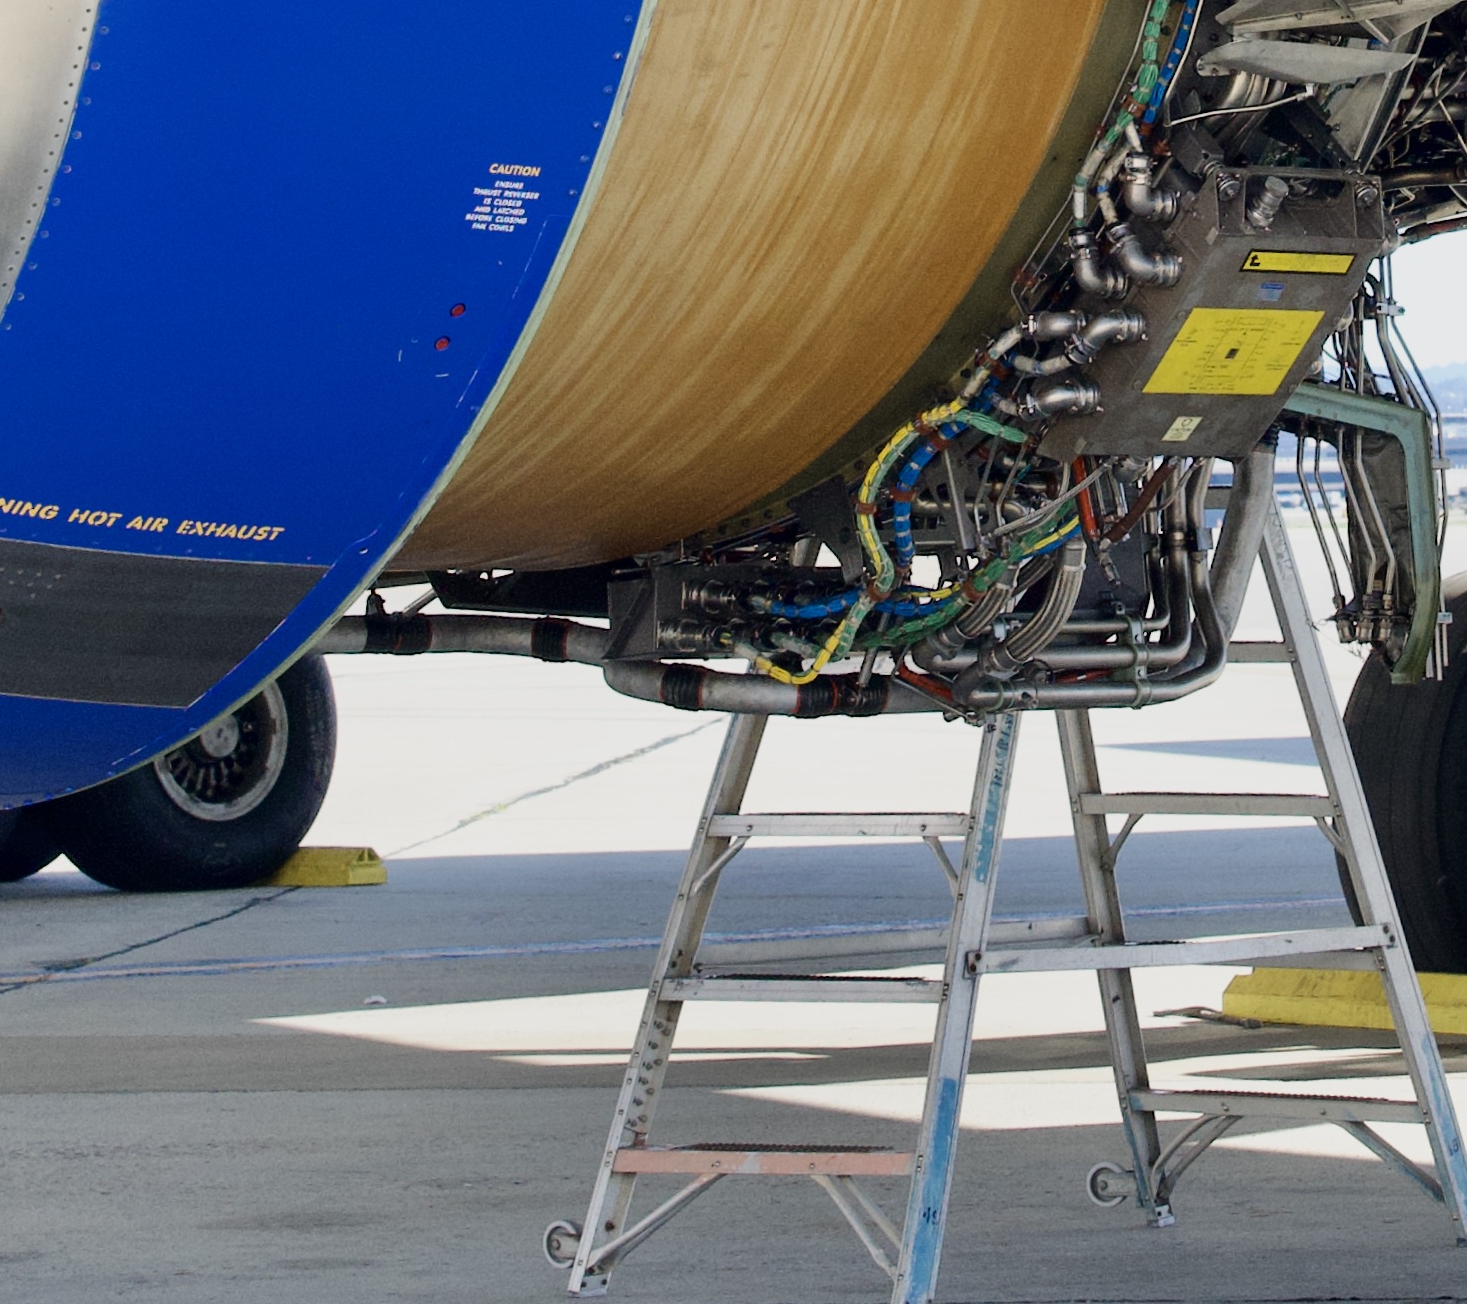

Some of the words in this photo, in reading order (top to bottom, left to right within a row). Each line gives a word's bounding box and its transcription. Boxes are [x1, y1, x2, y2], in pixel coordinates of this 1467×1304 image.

[489, 163, 541, 177] CAUTION
[495, 180, 524, 189] ENSURE
[473, 187, 502, 197] THRUST
[503, 189, 540, 200] REVERSER
[483, 197, 492, 205] IS
[494, 197, 522, 208] CLOSED
[474, 205, 491, 213] AND
[493, 206, 525, 216] LATCHED
[465, 213, 493, 222] BEFORE
[495, 215, 528, 225] CLOSING
[472, 222, 487, 230] FAN
[488, 223, 515, 232] COWLS
[68, 508, 122, 529] HOT
[126, 515, 169, 533] AIR
[176, 519, 285, 542] EXHAUST
